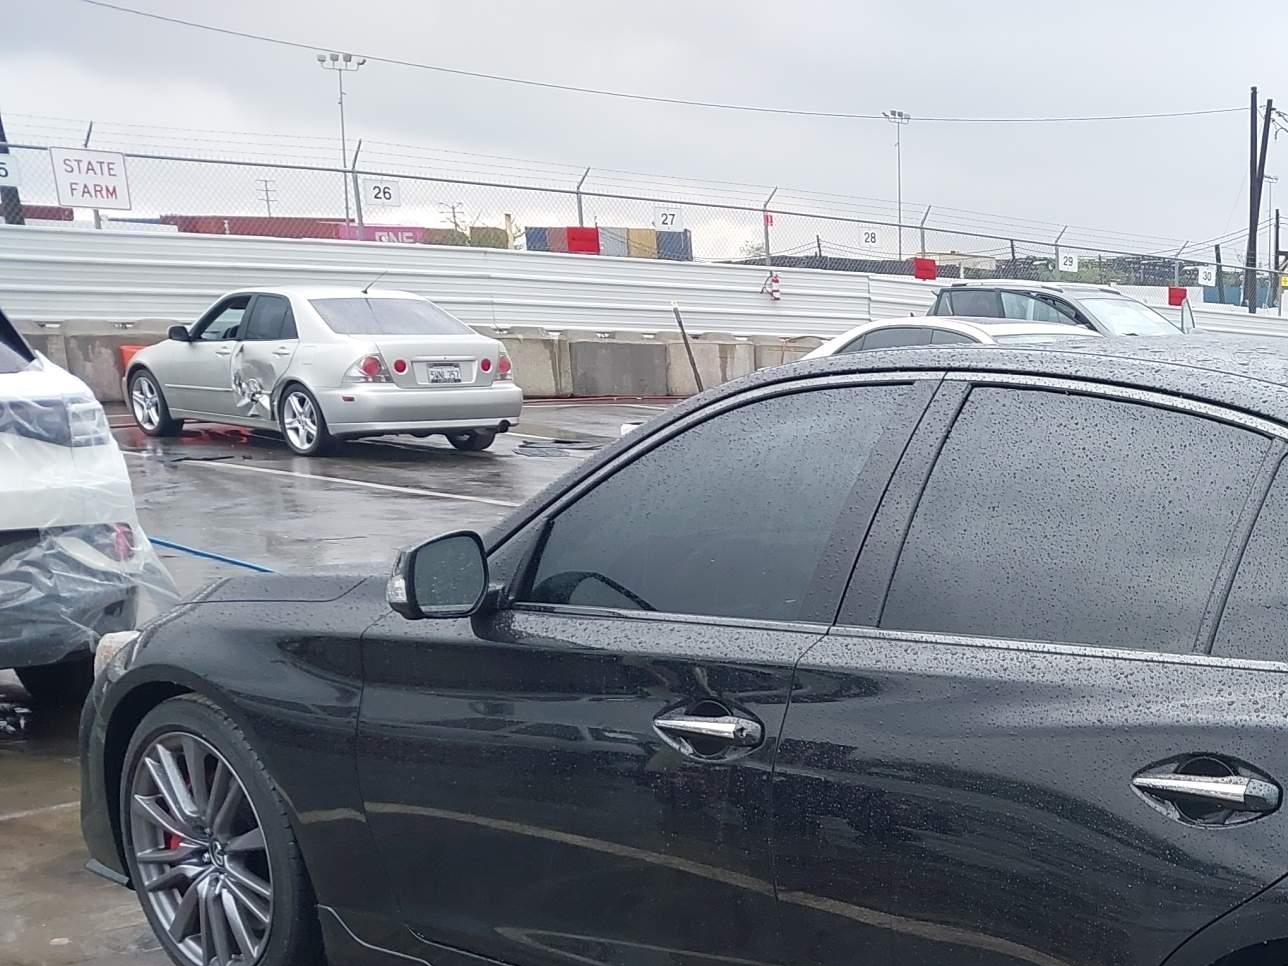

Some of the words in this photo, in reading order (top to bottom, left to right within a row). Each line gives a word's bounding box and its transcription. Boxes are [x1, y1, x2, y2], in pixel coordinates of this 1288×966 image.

[63, 159, 117, 176] STATE
[70, 182, 118, 199] FARM
[373, 186, 392, 200] 26
[661, 213, 675, 225] 27
[864, 232, 876, 243] 28
[1063, 256, 1073, 266] 29
[1202, 271, 1212, 281] 30
